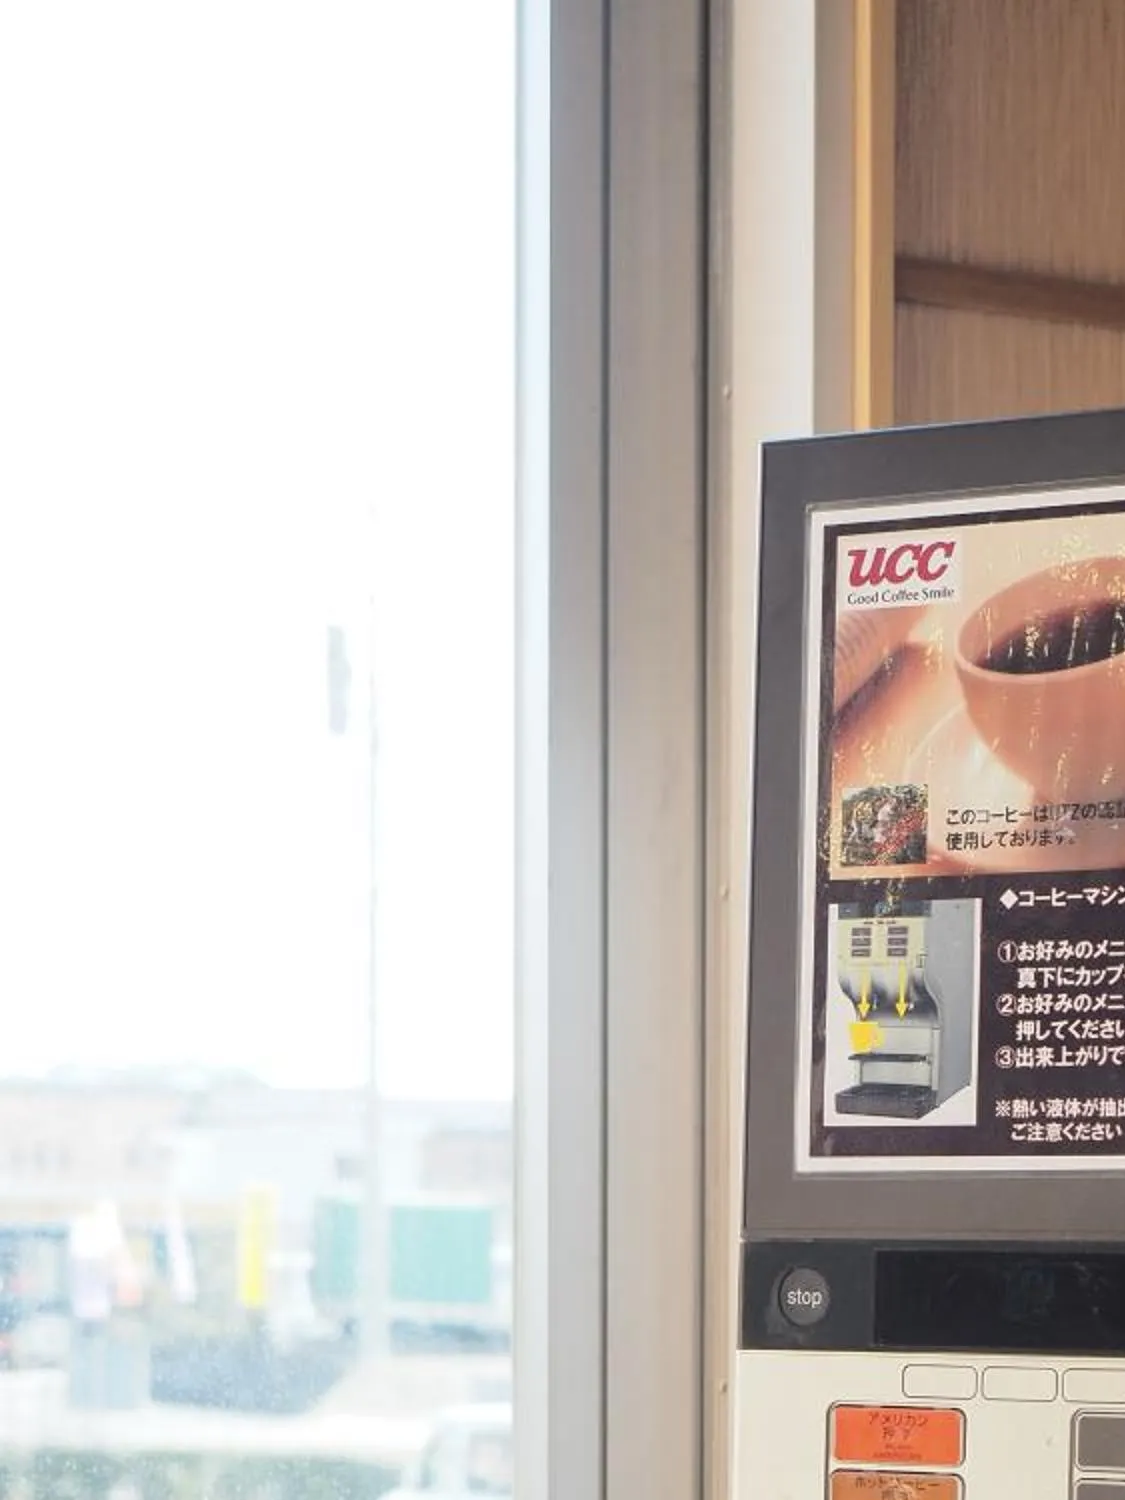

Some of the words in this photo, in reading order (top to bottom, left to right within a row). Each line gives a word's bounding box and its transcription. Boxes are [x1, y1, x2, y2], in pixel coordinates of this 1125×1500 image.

[847, 592, 879, 605] Good
[881, 589, 919, 602] Coffee
[921, 586, 955, 600] Smile
[1010, 1122, 1123, 1142] ご注意ください
[787, 1288, 822, 1309] stop
